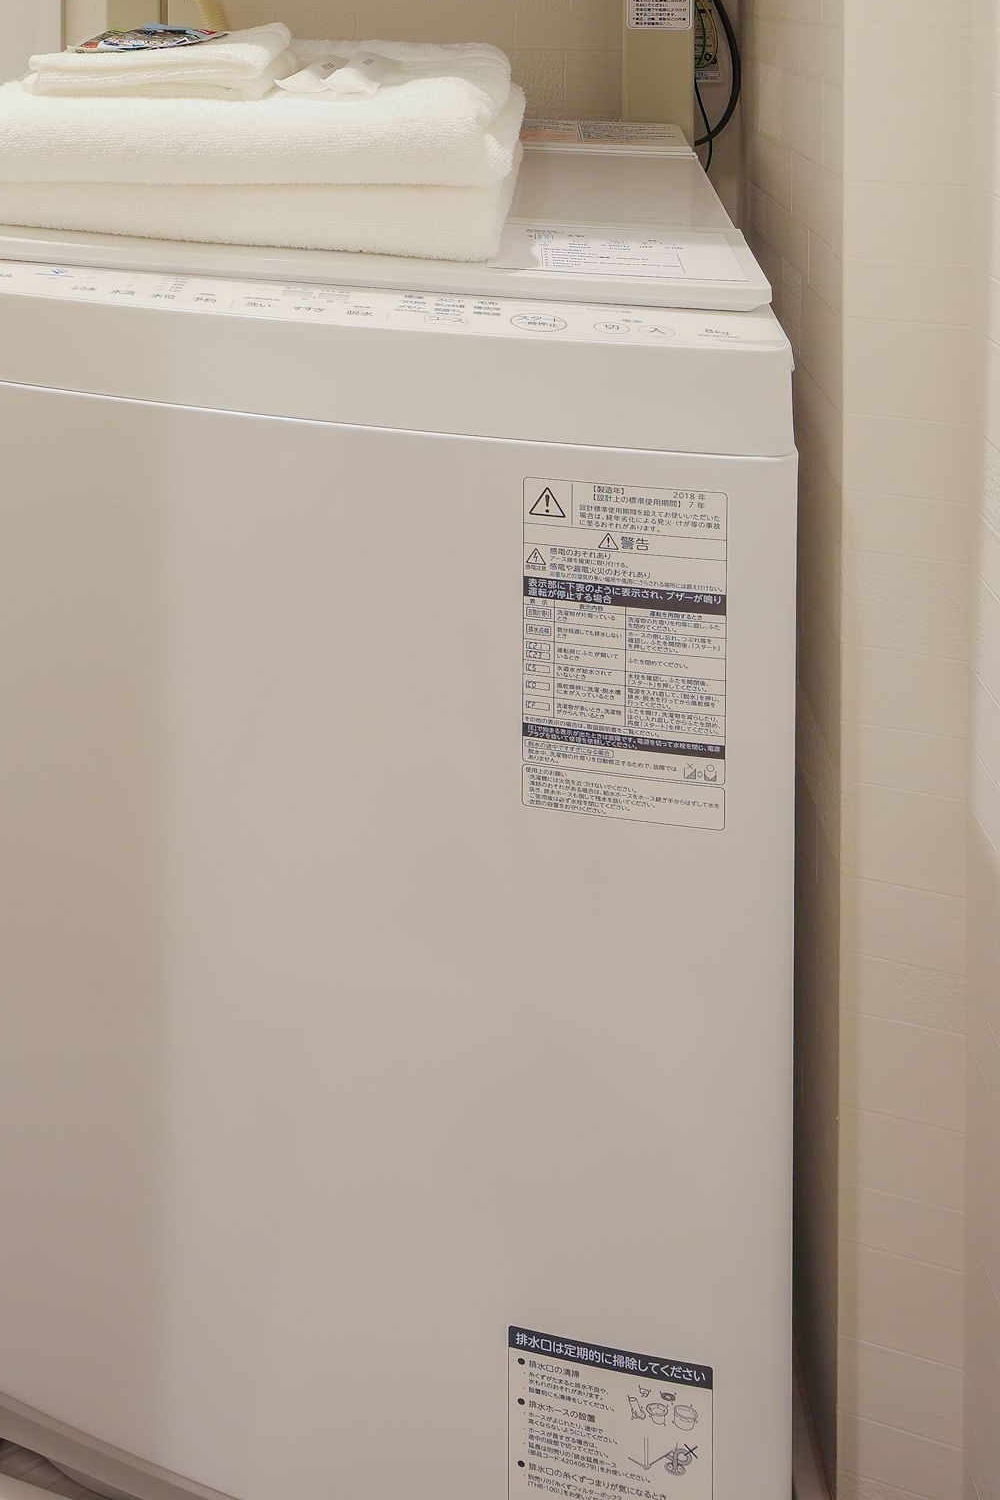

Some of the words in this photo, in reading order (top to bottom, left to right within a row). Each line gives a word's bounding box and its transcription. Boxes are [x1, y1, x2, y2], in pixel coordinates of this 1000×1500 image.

[549, 547, 610, 559] 感電のおそれあり
[620, 536, 649, 551] 警告
[527, 587, 612, 604] 運転が停止する場合
[528, 578, 721, 606] 表示部に下表のように表示され、ブザーが鳴り
[515, 1331, 705, 1384] 排水口は定期的に掃除してください
[528, 1359, 580, 1379] 排水口の清掃
[528, 1400, 595, 1423] 排水ホースの設置
